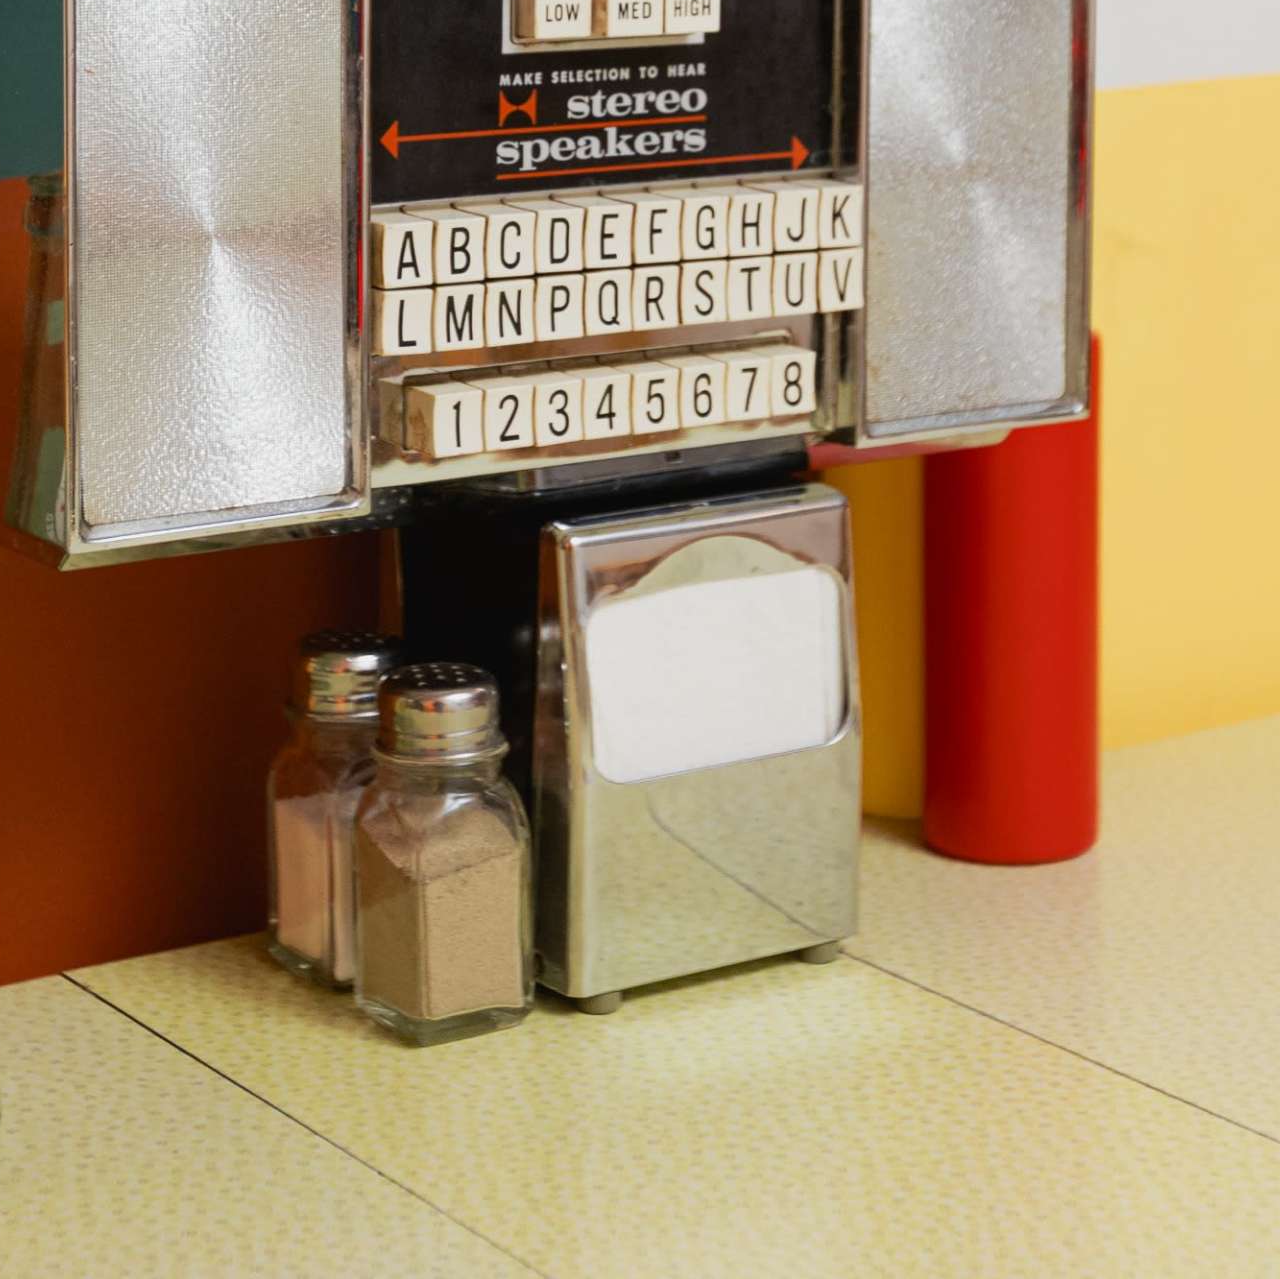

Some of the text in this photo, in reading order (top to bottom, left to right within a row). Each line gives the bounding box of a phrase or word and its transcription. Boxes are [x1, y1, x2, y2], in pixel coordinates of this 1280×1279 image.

[545, 3, 581, 22] LOW
[618, 1, 652, 20] MED
[499, 62, 707, 87] MAKE SELECTION TO HEAR
[566, 87, 708, 120] stereo
[496, 125, 708, 172] speakers
[397, 194, 852, 280] A B C D E F G H J K
[397, 257, 853, 347] L M N P Q R S T U V
[452, 362, 802, 448] 1 2 3 4 5 6 7 8
